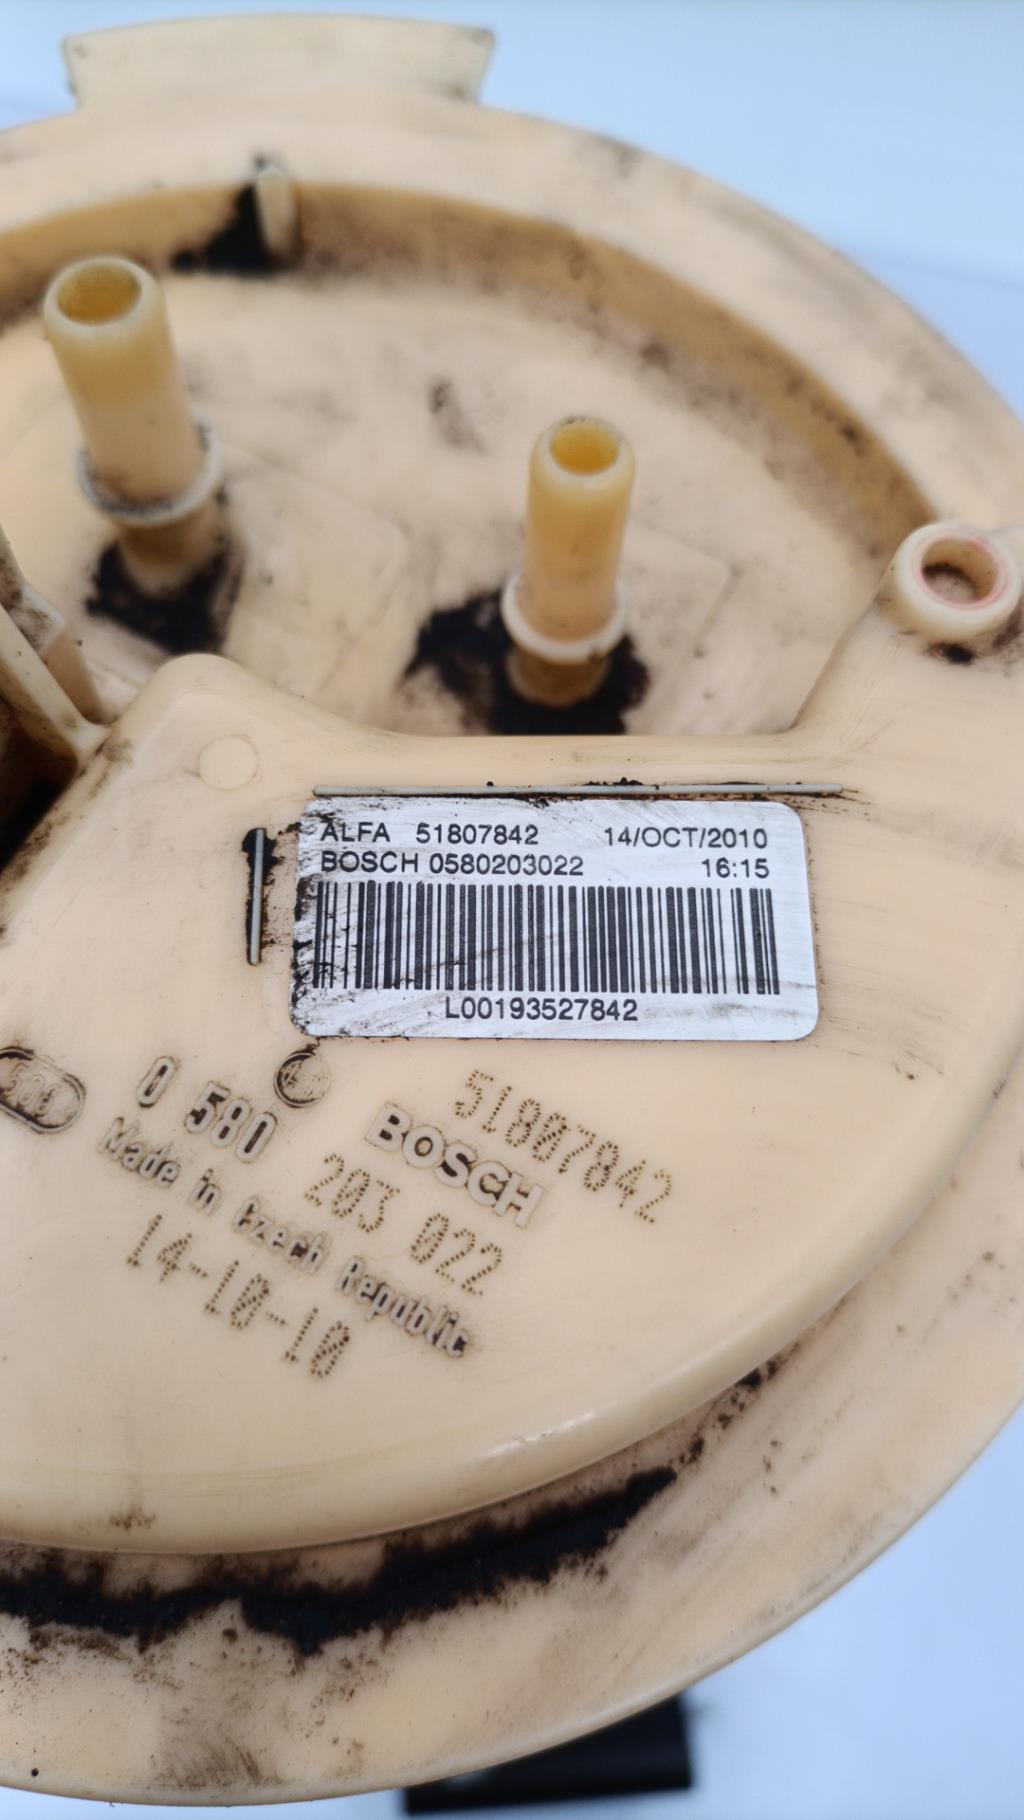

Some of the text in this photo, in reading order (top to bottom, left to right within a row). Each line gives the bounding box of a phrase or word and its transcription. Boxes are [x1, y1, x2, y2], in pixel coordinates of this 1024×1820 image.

[320, 822, 768, 849] ALFA 51807842 14/OCT/2010
[320, 851, 769, 879] BOSCH 0580203022 16:15
[445, 997, 638, 1022] L00193527842
[184, 1081, 278, 1163] 580
[304, 1154, 400, 1233] 203
[411, 1213, 503, 1297] 022
[363, 1101, 546, 1229] BOSCH
[454, 1069, 673, 1224] 51807842
[99, 1116, 472, 1359] Made in Czech Republic
[126, 1213, 350, 1379] 14-10-10
